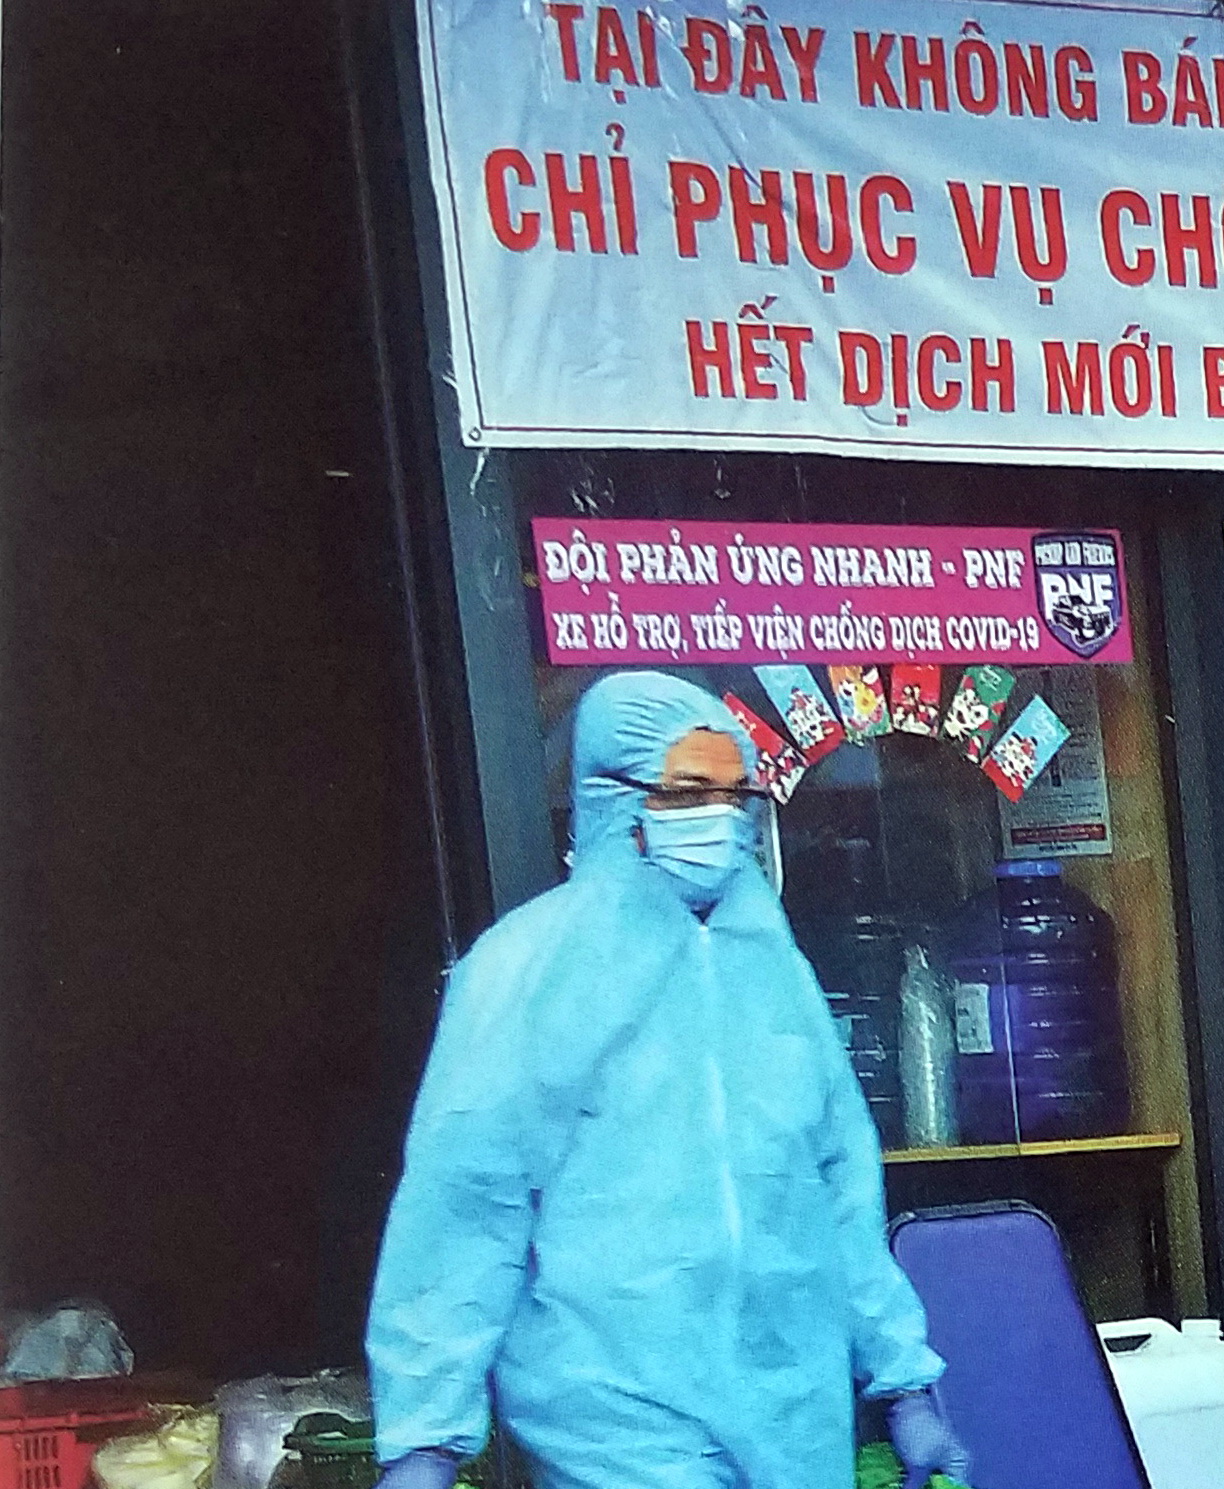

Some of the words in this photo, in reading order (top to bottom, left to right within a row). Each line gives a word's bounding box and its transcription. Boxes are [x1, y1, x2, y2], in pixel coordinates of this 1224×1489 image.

[545, 3, 662, 104] TẠI
[682, 3, 825, 103] ĐÂY
[853, 20, 1098, 123] KHÔNG
[484, 122, 638, 256] CHỈ
[667, 159, 918, 294] PHỤC
[946, 180, 1069, 306] VỤ
[684, 294, 813, 402] HẾT
[837, 329, 1016, 427] DỊCH
[1040, 324, 1178, 420] MỚI
[542, 527, 612, 596] ĐỘI
[616, 527, 720, 586] PHẢN
[810, 545, 935, 589] NHANH
[963, 548, 1025, 589] PNF
[552, 612, 589, 650] XE
[809, 599, 886, 652] CHỐNG
[888, 615, 944, 660] DỊCH
[946, 615, 1041, 652] COVID-19
